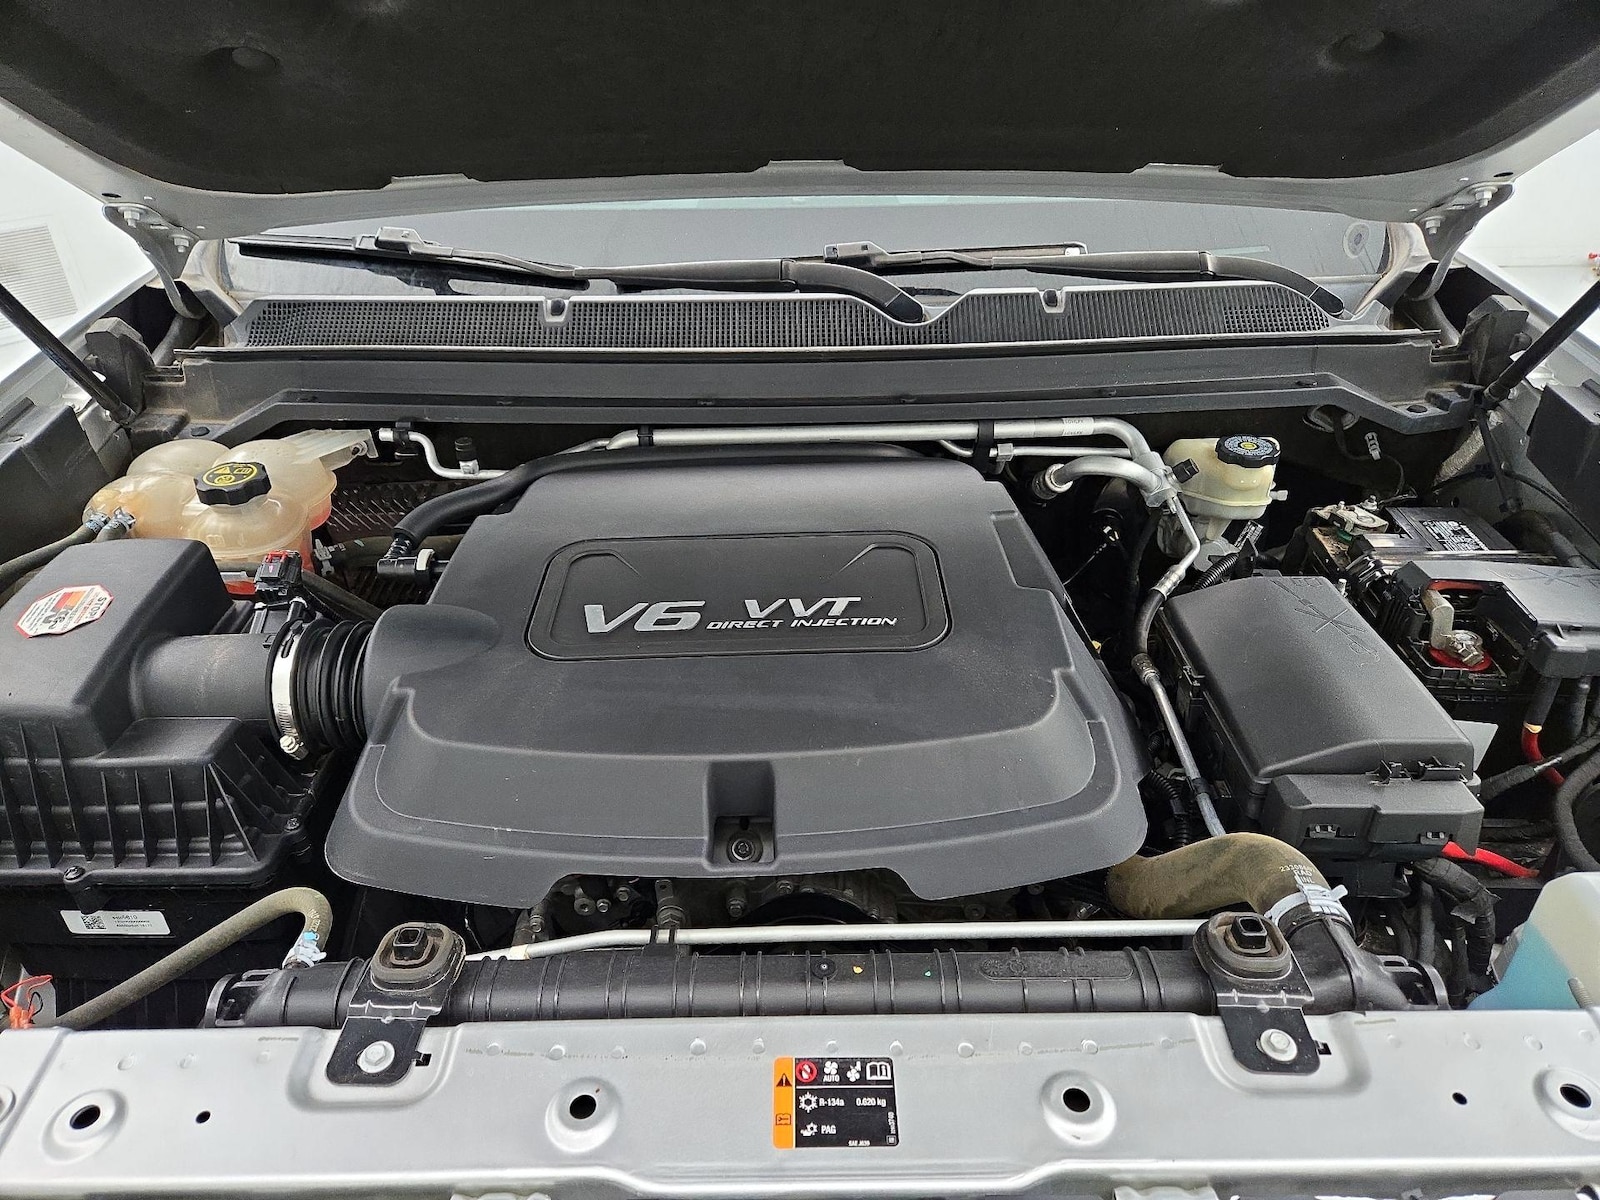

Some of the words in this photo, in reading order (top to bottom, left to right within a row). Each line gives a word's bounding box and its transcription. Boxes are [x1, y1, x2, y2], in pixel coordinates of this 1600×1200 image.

[584, 600, 706, 633] V6
[744, 597, 862, 619] VVT
[706, 620, 784, 630] DIRECT
[790, 617, 898, 628] INJECTION
[823, 1074, 840, 1082] AUTO
[819, 1097, 845, 1107] R-134a
[856, 1097, 877, 1107] 0.620
[877, 1097, 887, 1108] kg
[821, 1125, 837, 1134] PAG
